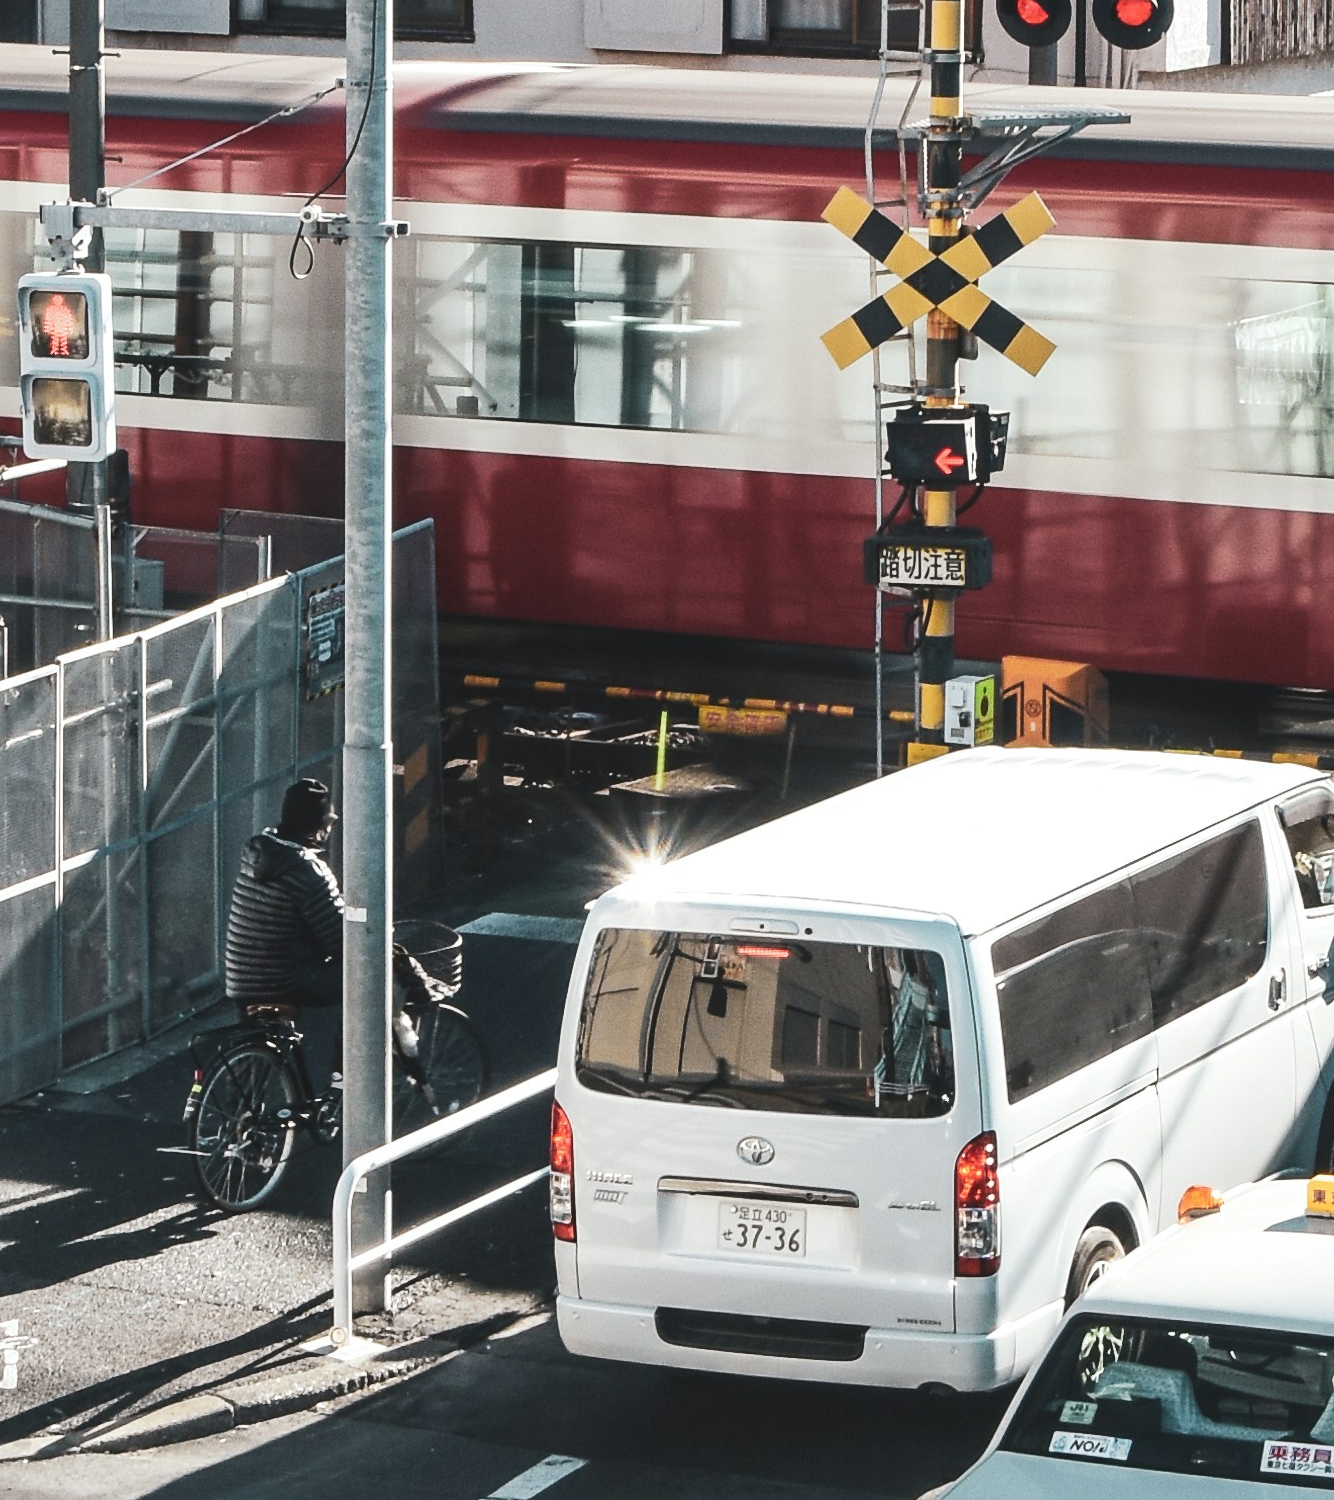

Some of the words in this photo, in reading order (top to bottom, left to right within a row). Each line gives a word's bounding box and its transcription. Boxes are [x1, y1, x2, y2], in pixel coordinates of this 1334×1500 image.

[880, 547, 964, 581] 踏切注意
[736, 1223, 800, 1252] 37-36
